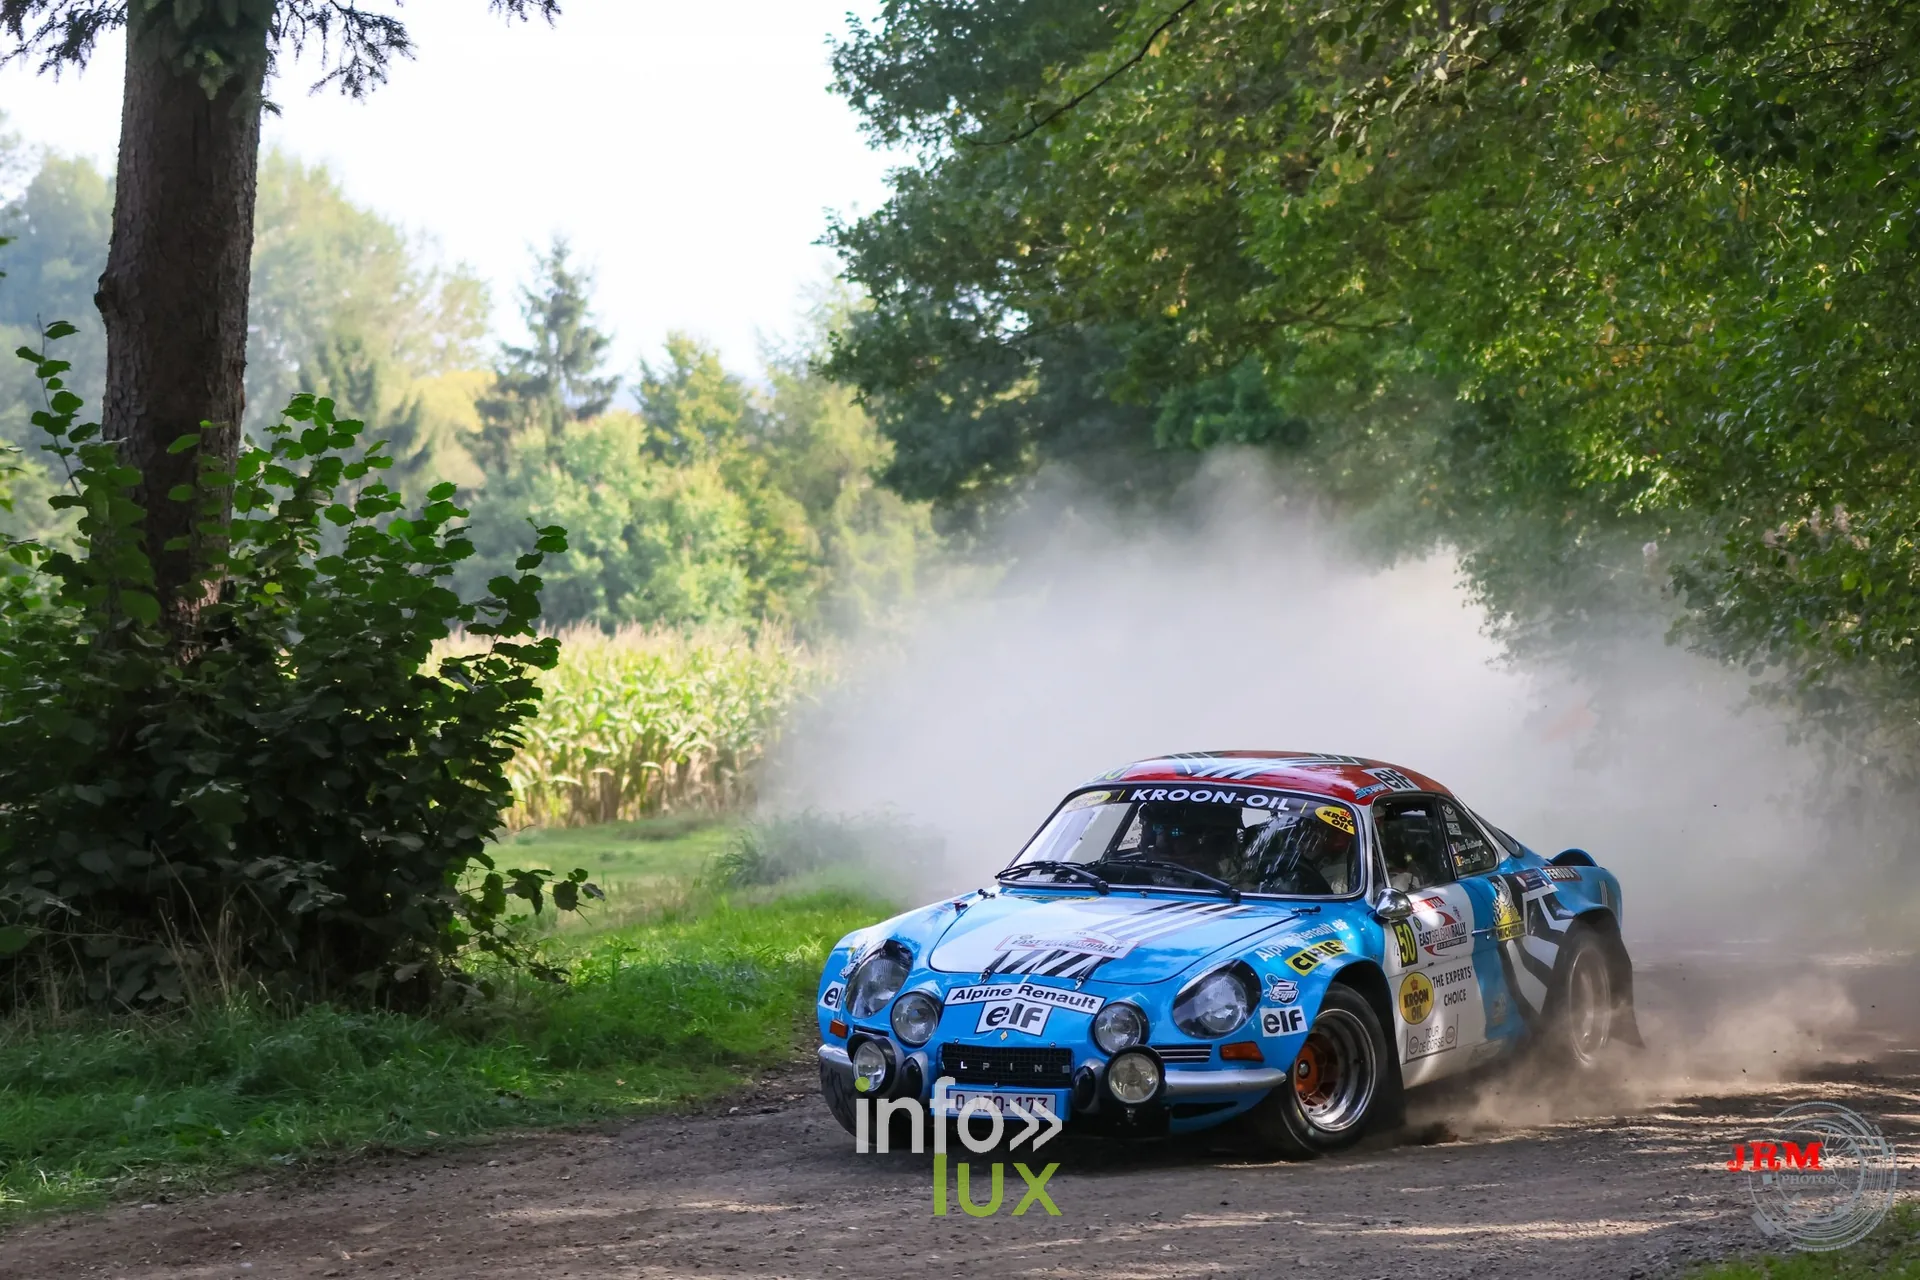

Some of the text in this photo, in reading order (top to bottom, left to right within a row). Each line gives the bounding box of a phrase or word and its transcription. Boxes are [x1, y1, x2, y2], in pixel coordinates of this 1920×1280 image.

[1374, 769, 1414, 789] elf
[1130, 788, 1290, 811] KROON-OIL
[1331, 819, 1349, 831] OIL
[1396, 923, 1417, 963] 50
[1432, 974, 1445, 989] THE
[952, 984, 1097, 1010] Alpine Renault
[1403, 988, 1430, 1008] KROON
[1443, 989, 1467, 1007] CHOICE
[986, 1002, 1044, 1029] elf
[1263, 1009, 1302, 1034] elf
[1411, 1005, 1423, 1020] OIL
